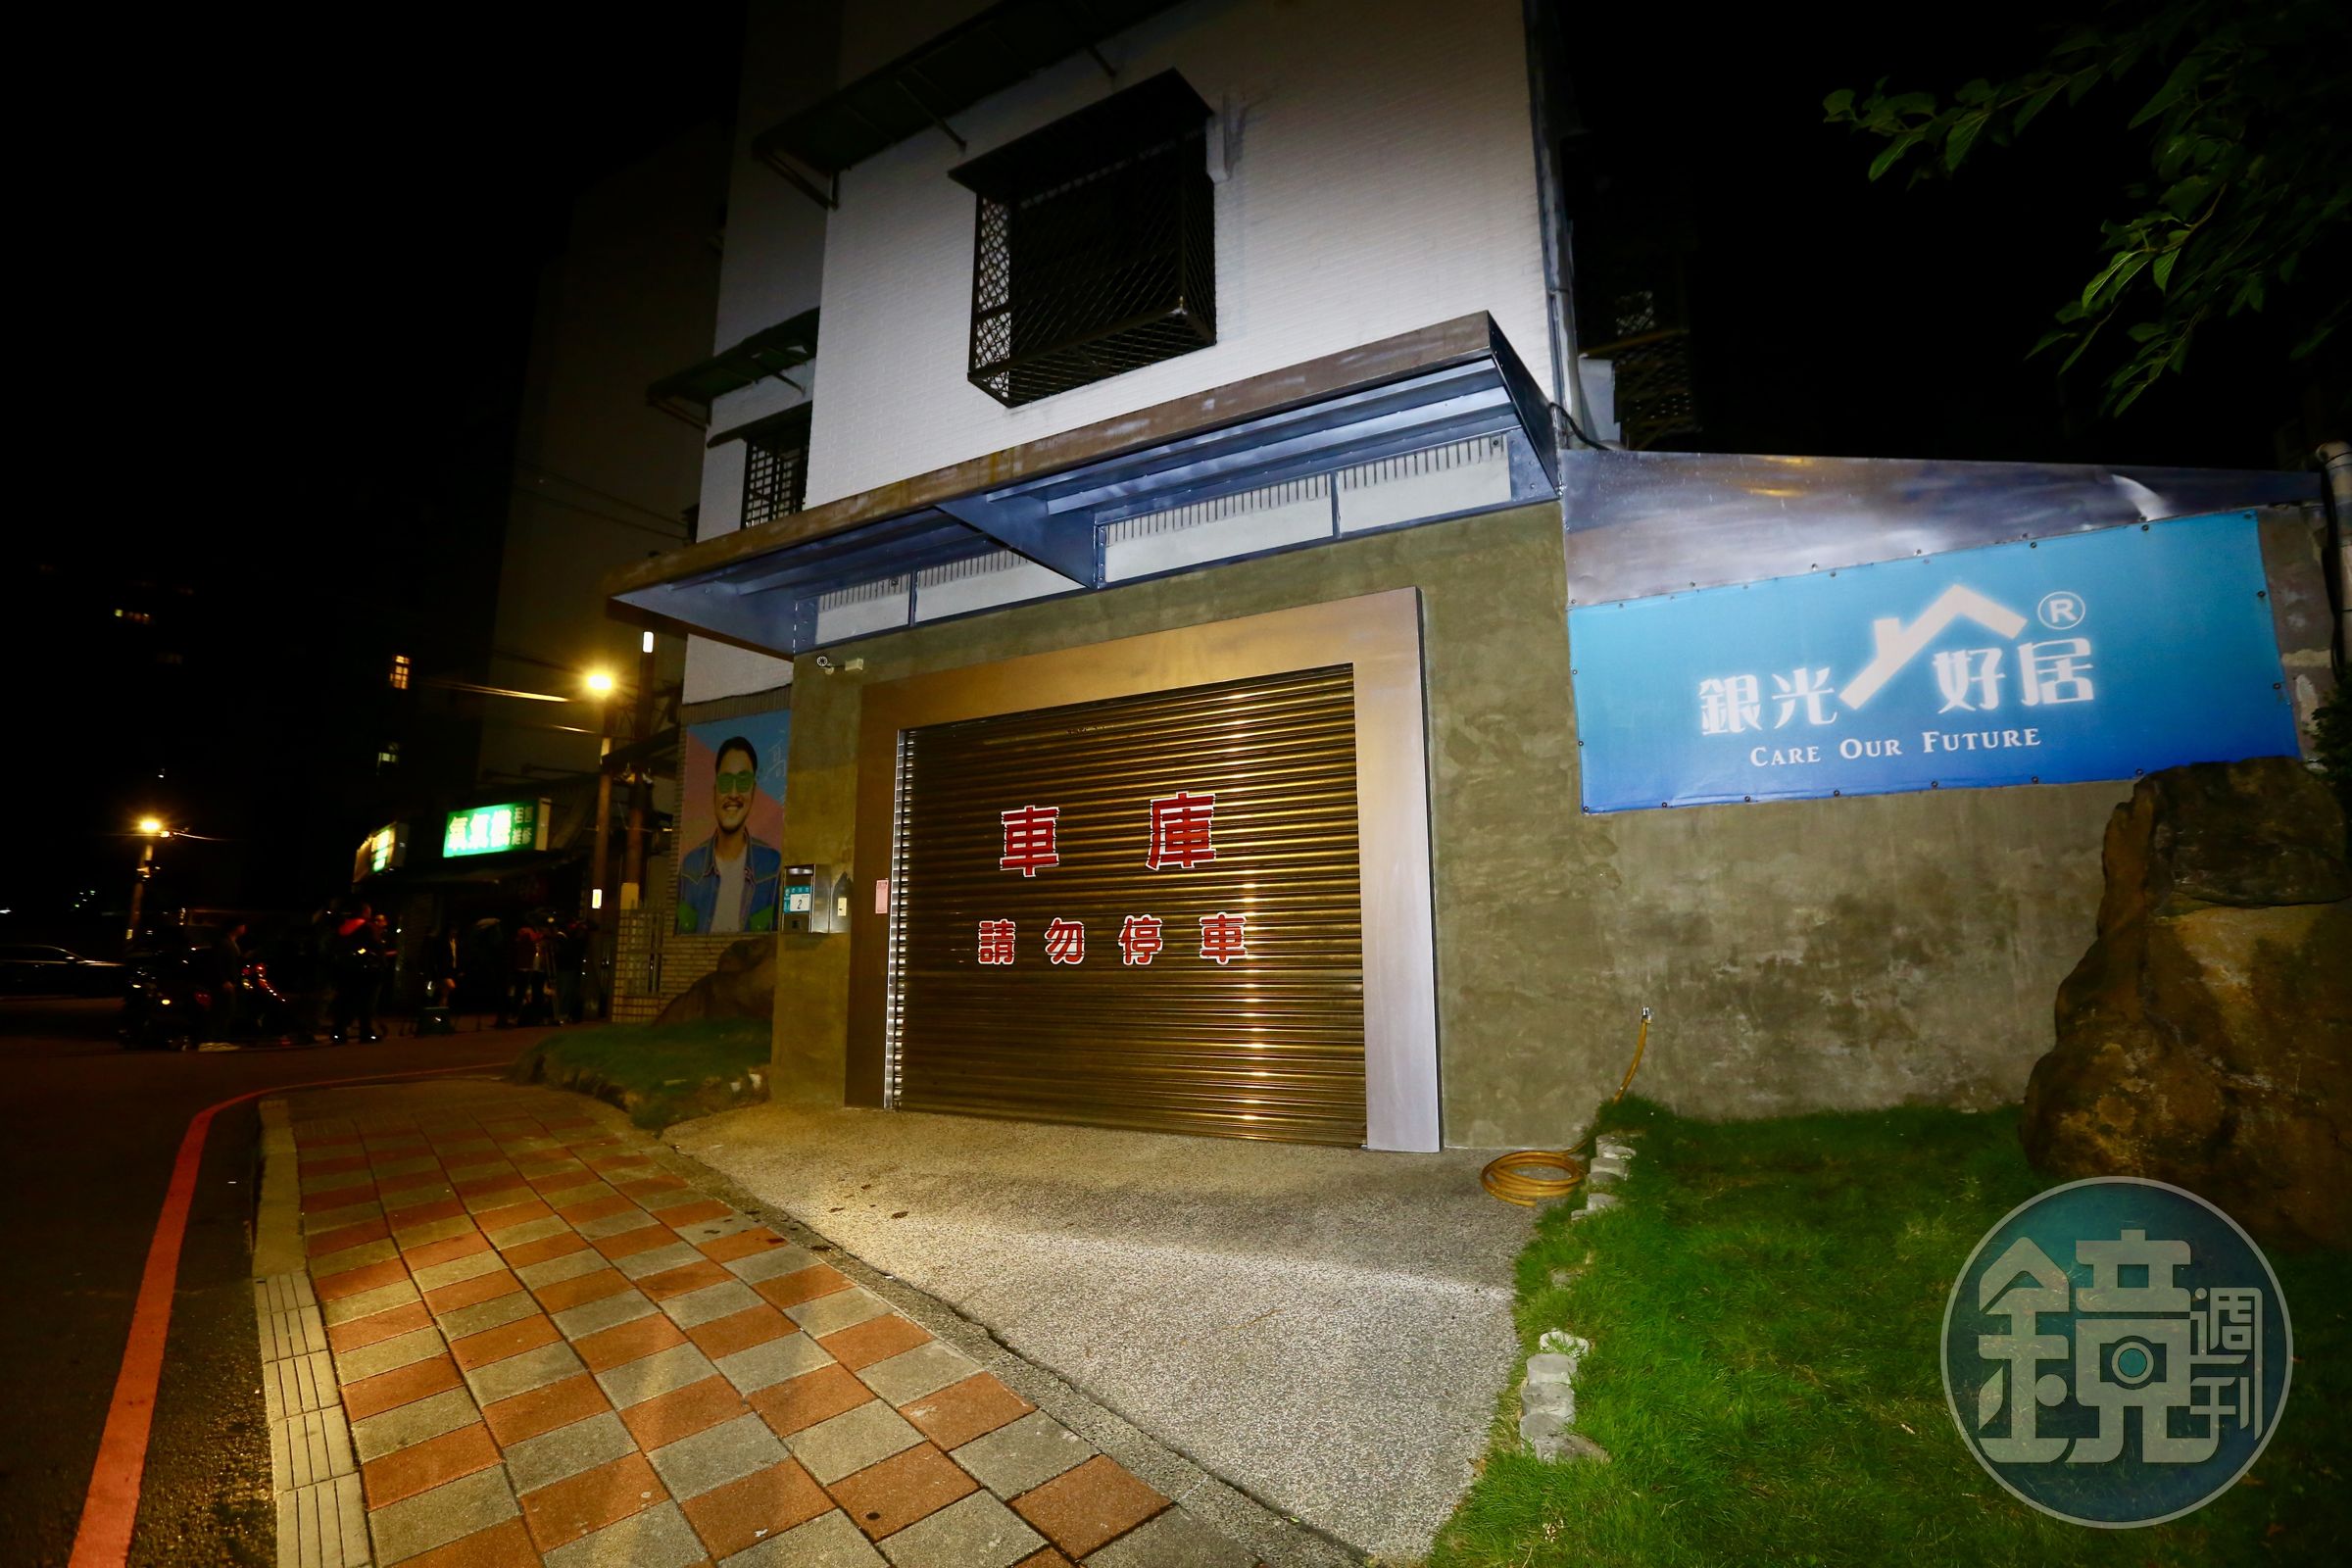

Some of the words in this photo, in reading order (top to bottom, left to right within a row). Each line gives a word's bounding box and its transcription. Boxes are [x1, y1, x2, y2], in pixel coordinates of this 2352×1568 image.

[1749, 745, 1822, 767] CARE
[1838, 737, 1902, 760] OUR
[1922, 727, 2042, 754] FUTURE
[999, 791, 1217, 878] 車庫
[977, 911, 1249, 966] 請勿停車
